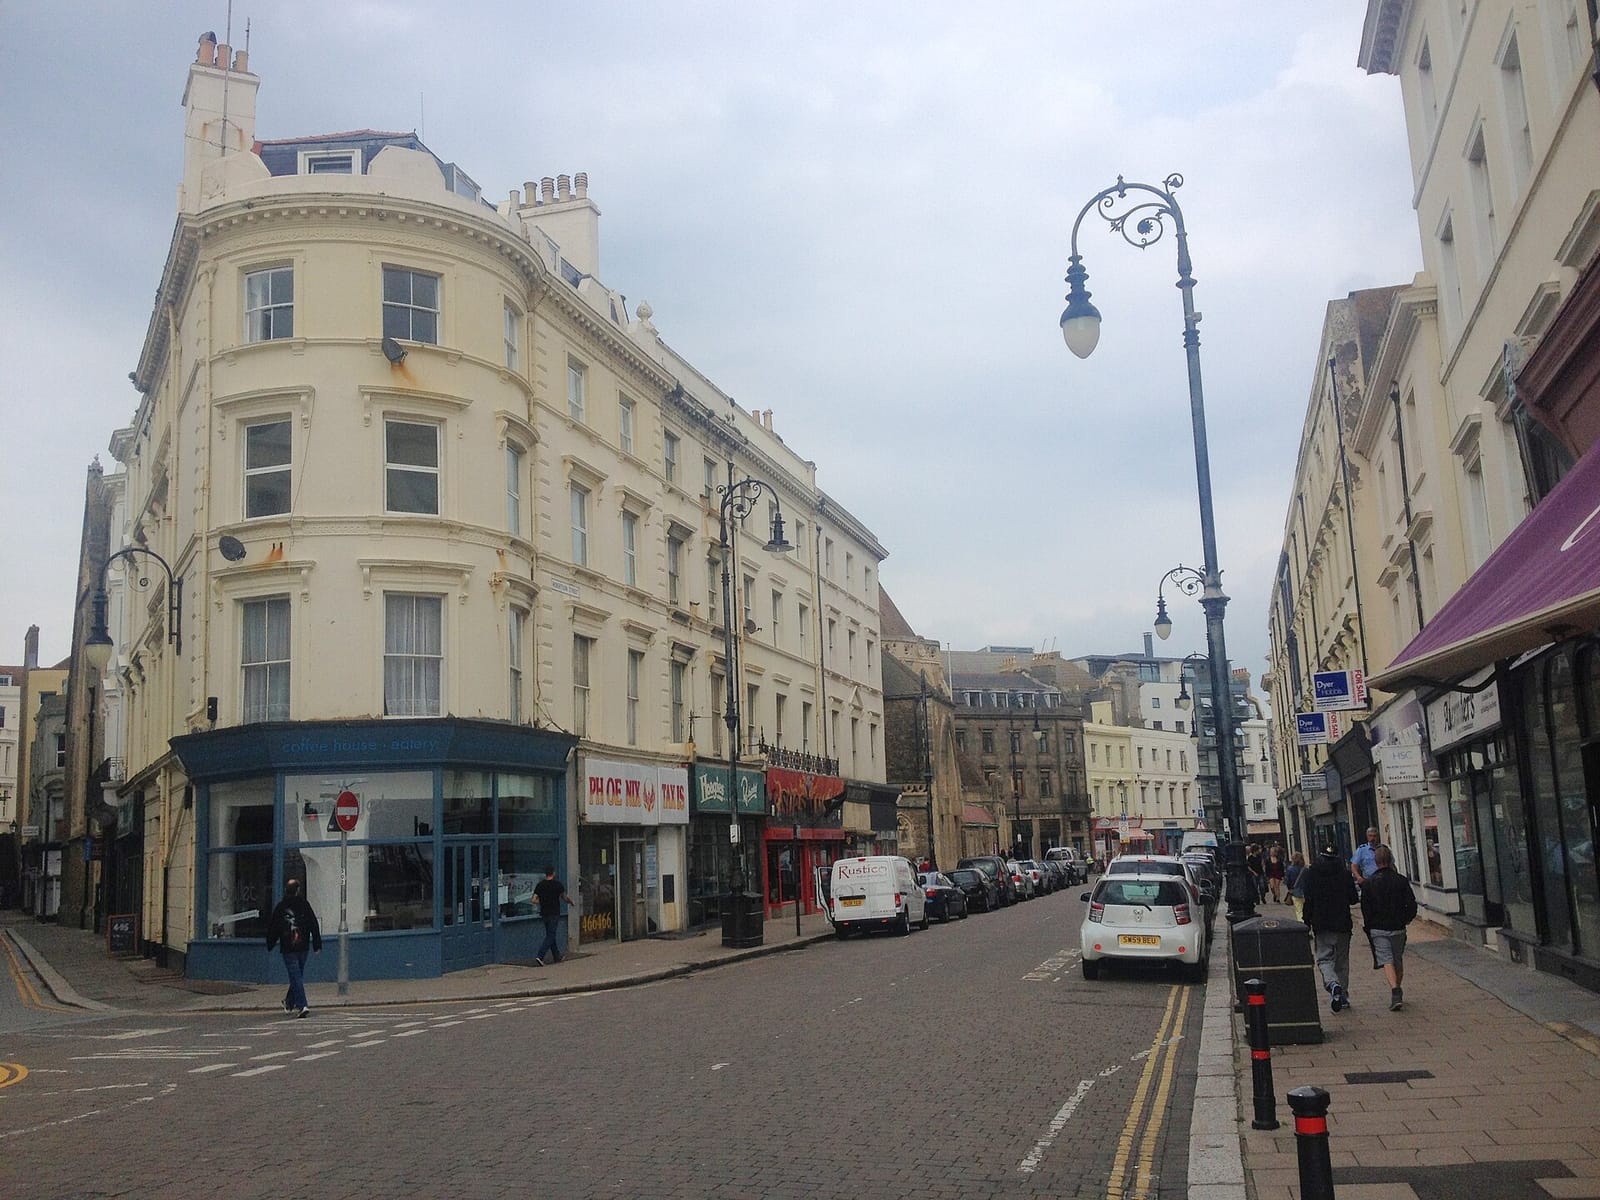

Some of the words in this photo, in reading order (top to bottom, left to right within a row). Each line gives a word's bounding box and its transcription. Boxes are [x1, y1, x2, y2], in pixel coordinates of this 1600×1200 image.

[1316, 680, 1334, 690] Dyer
[1299, 719, 1313, 727] Dyer
[281, 737, 328, 753] coffee
[332, 738, 377, 753] house
[661, 783, 686, 810] TAXIS
[838, 864, 887, 880] Rustico
[582, 911, 612, 932] 466466
